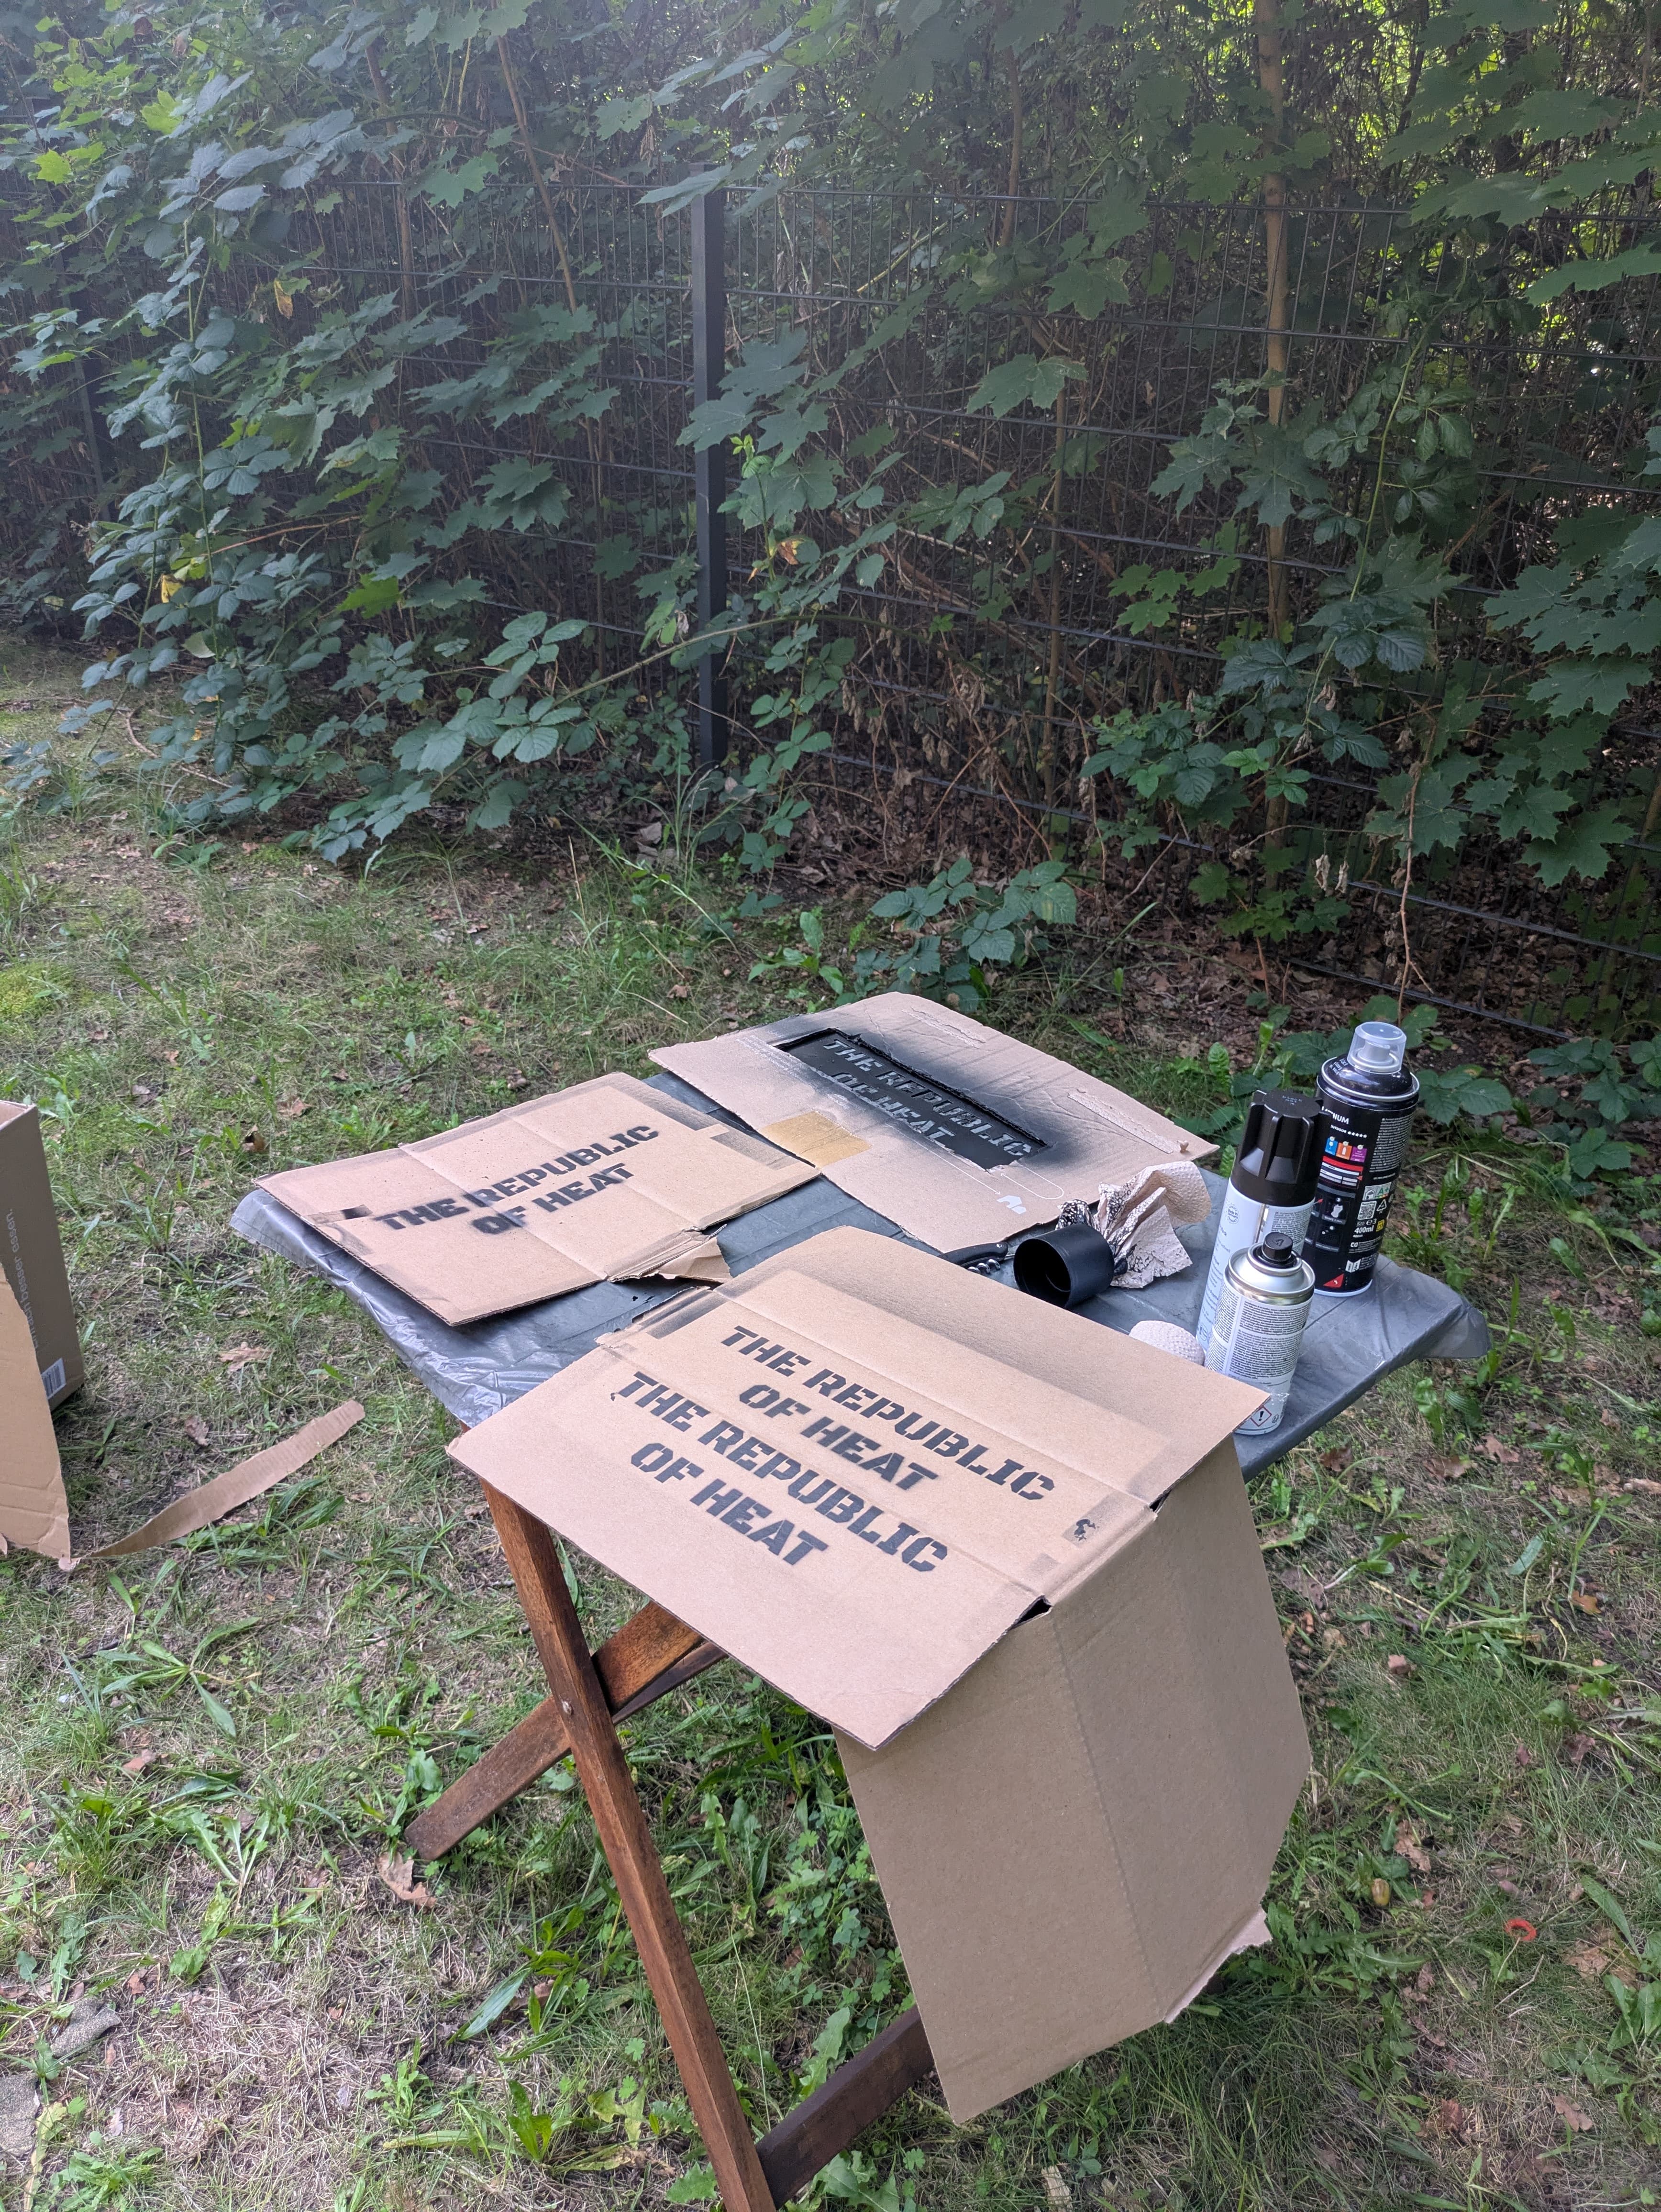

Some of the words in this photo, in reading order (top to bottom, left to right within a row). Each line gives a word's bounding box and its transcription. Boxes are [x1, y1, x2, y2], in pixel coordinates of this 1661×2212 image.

[823, 1039, 883, 1072] THE
[876, 1071, 1031, 1156] REPUBLIC
[831, 1073, 878, 1099] OF
[878, 1093, 955, 1139] HEAT
[373, 1198, 469, 1230] THE
[462, 1126, 659, 1207] REPUBLIC
[472, 1206, 526, 1234] OF
[532, 1163, 634, 1212] HEAT
[1354, 1225, 1374, 1234] 400ml
[7, 1209, 20, 1253] essen.
[14, 1256, 29, 1303] besser
[721, 1326, 811, 1376] THE
[802, 1369, 1054, 1500] REPUBLIC
[739, 1385, 810, 1417] OF
[800, 1416, 939, 1491] HEAT
[617, 1372, 710, 1432] THE
[698, 1420, 948, 1572] REPUBLIC
[631, 1443, 704, 1483] OF
[690, 1479, 828, 1565] HEAT
